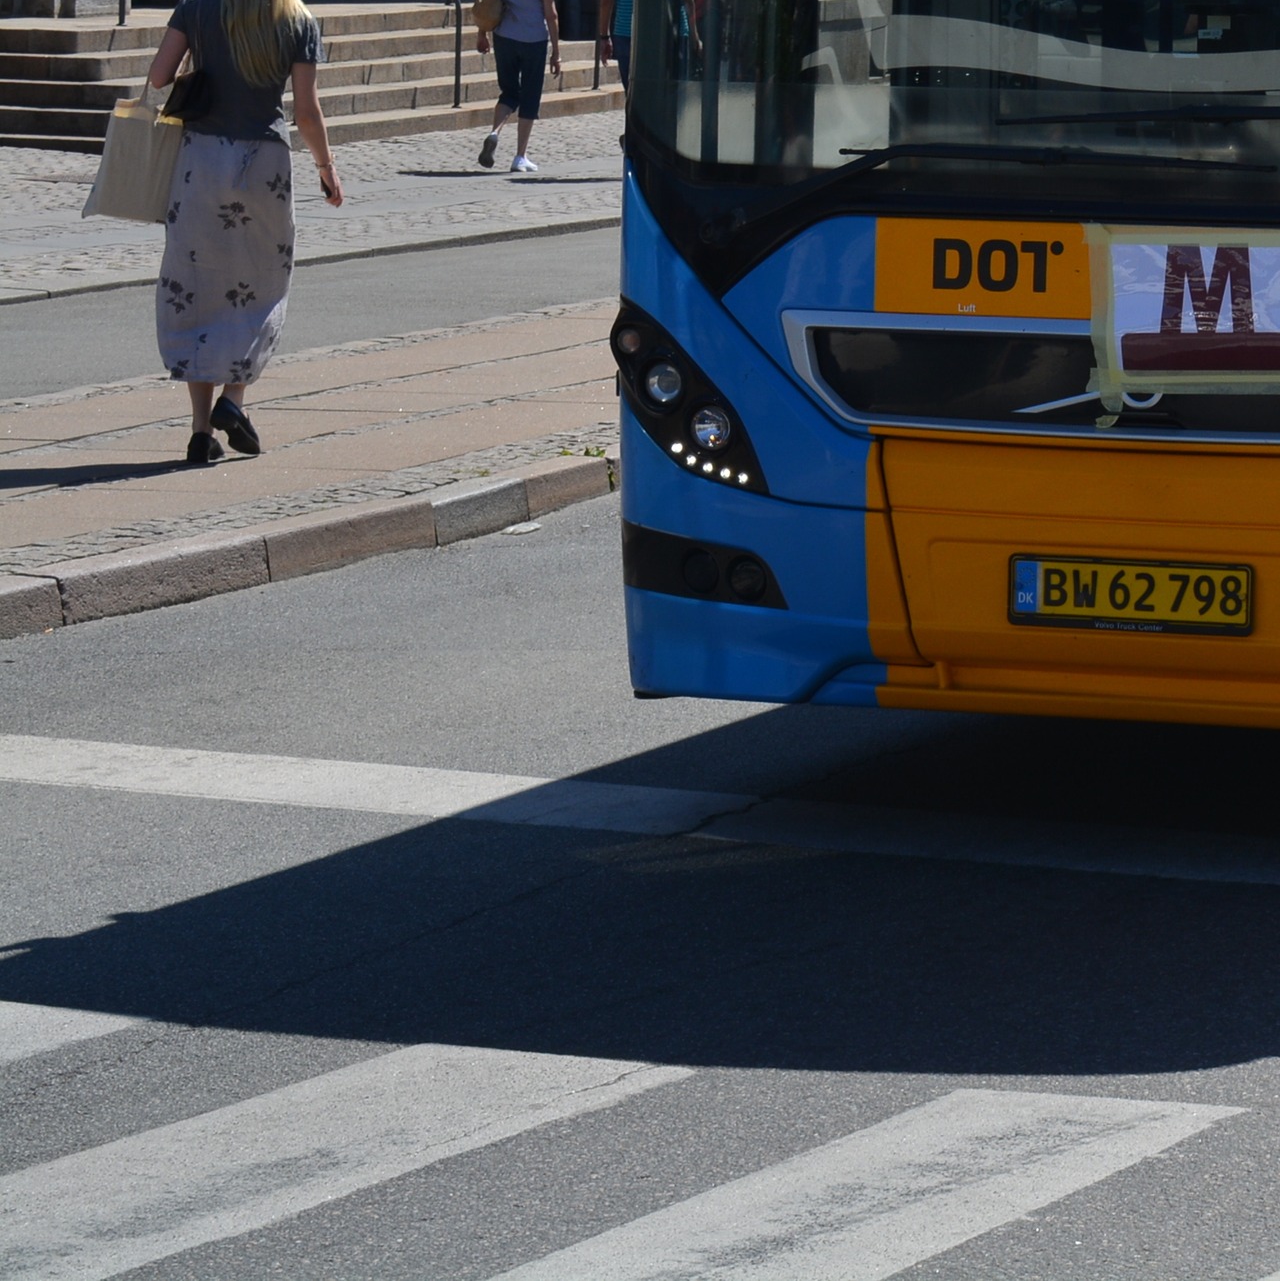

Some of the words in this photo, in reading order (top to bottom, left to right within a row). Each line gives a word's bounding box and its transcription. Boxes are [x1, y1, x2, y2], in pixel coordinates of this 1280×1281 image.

[933, 238, 1056, 293] DOT
[1158, 244, 1256, 334] M
[957, 303, 977, 313] Luft
[1017, 591, 1034, 604] DK
[1043, 568, 1098, 608] BW
[1108, 570, 1156, 612] 62
[1168, 574, 1243, 616] 798
[1094, 621, 1116, 629] Volvo
[1116, 622, 1137, 631] Truck
[1138, 623, 1163, 632] Center
